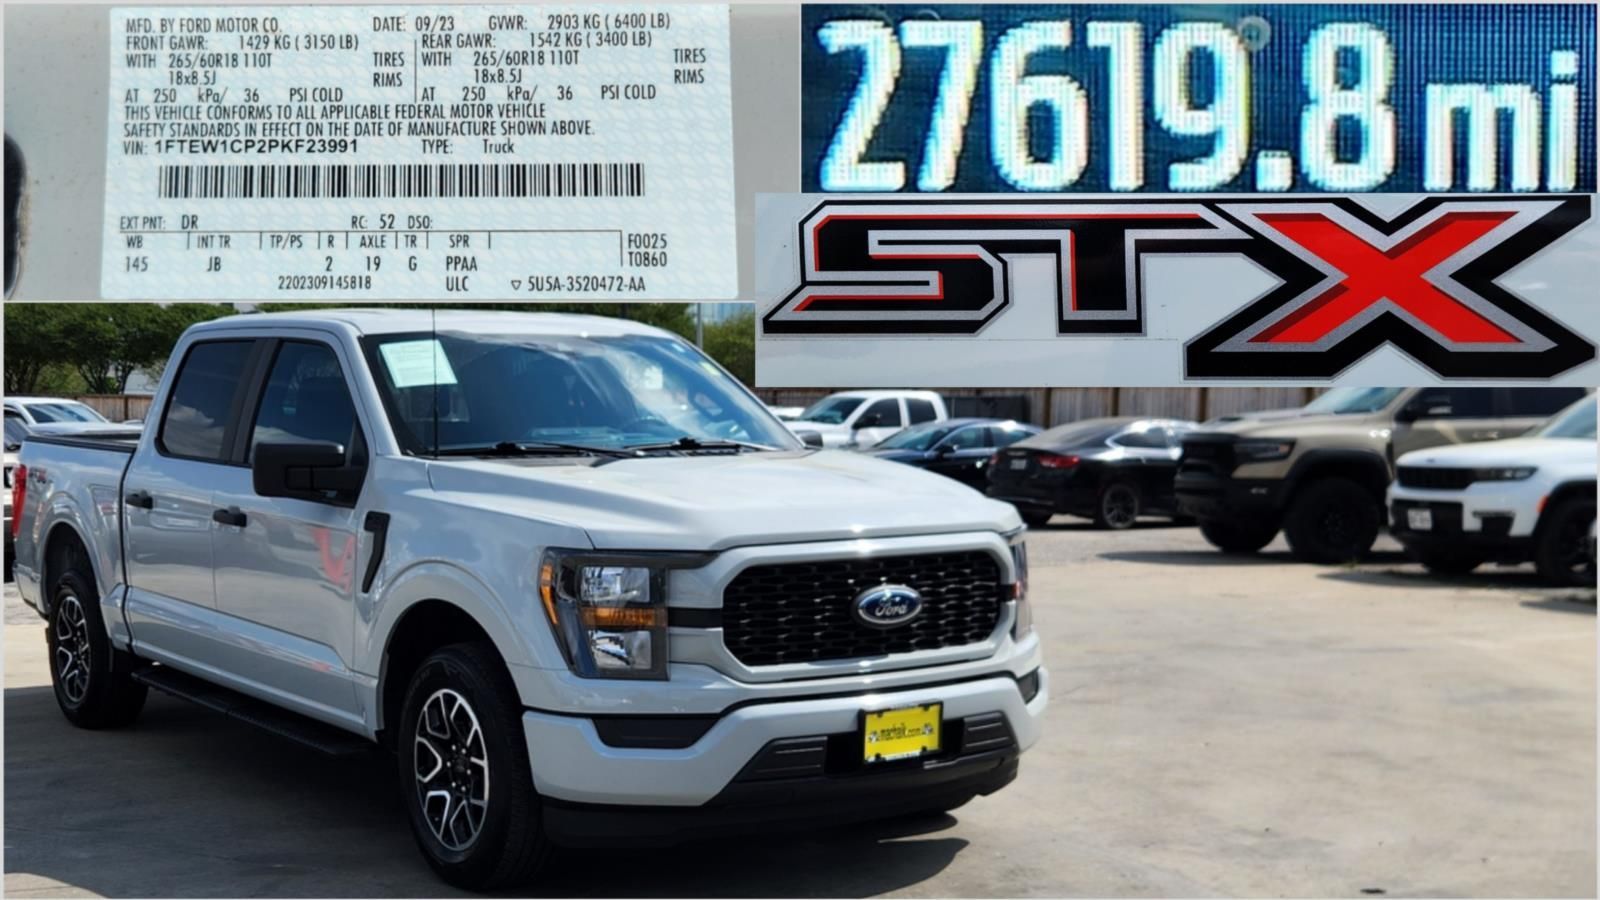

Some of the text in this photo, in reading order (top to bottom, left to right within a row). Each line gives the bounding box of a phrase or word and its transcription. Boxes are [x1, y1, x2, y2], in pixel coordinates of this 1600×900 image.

[126, 18, 283, 33] MFD. BY FORD MOTOR CO.
[372, 16, 455, 32] DATE: 09/23
[488, 15, 528, 31] GVWR:
[547, 15, 580, 30] 2903
[583, 14, 600, 30] KG
[614, 14, 647, 30] 6400
[650, 13, 671, 29] LB)
[126, 35, 164, 51] FRONT
[169, 35, 208, 51] GAWR:
[239, 35, 269, 50] 1429
[274, 35, 291, 50] KG
[304, 35, 335, 49] 3150
[339, 34, 359, 50] LB)
[422, 33, 453, 49] REAR
[456, 33, 496, 49] GAWR:
[529, 32, 561, 48] 1542
[565, 32, 583, 47] KG
[596, 31, 628, 47] 3400
[632, 31, 652, 47] LB)
[126, 52, 272, 69] WITH 265/60R18 110T
[373, 52, 405, 67] TIRES
[422, 49, 580, 67] WITH 265/60R18 110T
[673, 49, 706, 64] TIRES
[169, 71, 217, 86] 18x8.5J
[373, 72, 403, 87] RIMS
[474, 68, 522, 84] 18x8.5J
[673, 69, 705, 84] RIMS
[125, 87, 343, 105] AT 250 kPa/ 36 PSI COLD
[421, 84, 656, 103] AT 250 kPa/ 36 PSI COLD
[123, 103, 546, 121] THIS VEHICLE CONFORMS TO ALL APPLICABLE FEDERAL MOTOR VEHICLE
[818, 20, 1579, 192] 27619.8 mi
[123, 120, 595, 138] SAFETY STANDARDS IN EFFECT ON THE DATE OF MANUFACTURE SHOWN ABOVE.
[123, 139, 358, 156] VIN: 1FTEW1CP2PKF23991
[421, 138, 515, 154] TYPE: Truck
[120, 214, 199, 230] EXT PNT: DR
[379, 214, 395, 229] 52
[407, 215, 433, 230] DSO:
[126, 234, 143, 248] WB
[197, 234, 231, 248] INT TR
[270, 233, 303, 250] TP/PS
[328, 234, 335, 248] R
[359, 234, 387, 248] AXLE
[404, 234, 417, 248] TR
[449, 234, 470, 248] SPR
[125, 256, 149, 272] 145
[206, 256, 221, 272] JB
[325, 256, 333, 272] 2
[366, 256, 381, 271] 19
[408, 256, 417, 271] G
[446, 256, 478, 271] PPAA
[278, 276, 372, 290] 2202309145818
[446, 276, 469, 292] ULC
[528, 276, 646, 292] 5U5A-3520472-AA
[762, 196, 1596, 379] STX
[875, 598, 908, 616] Ford
